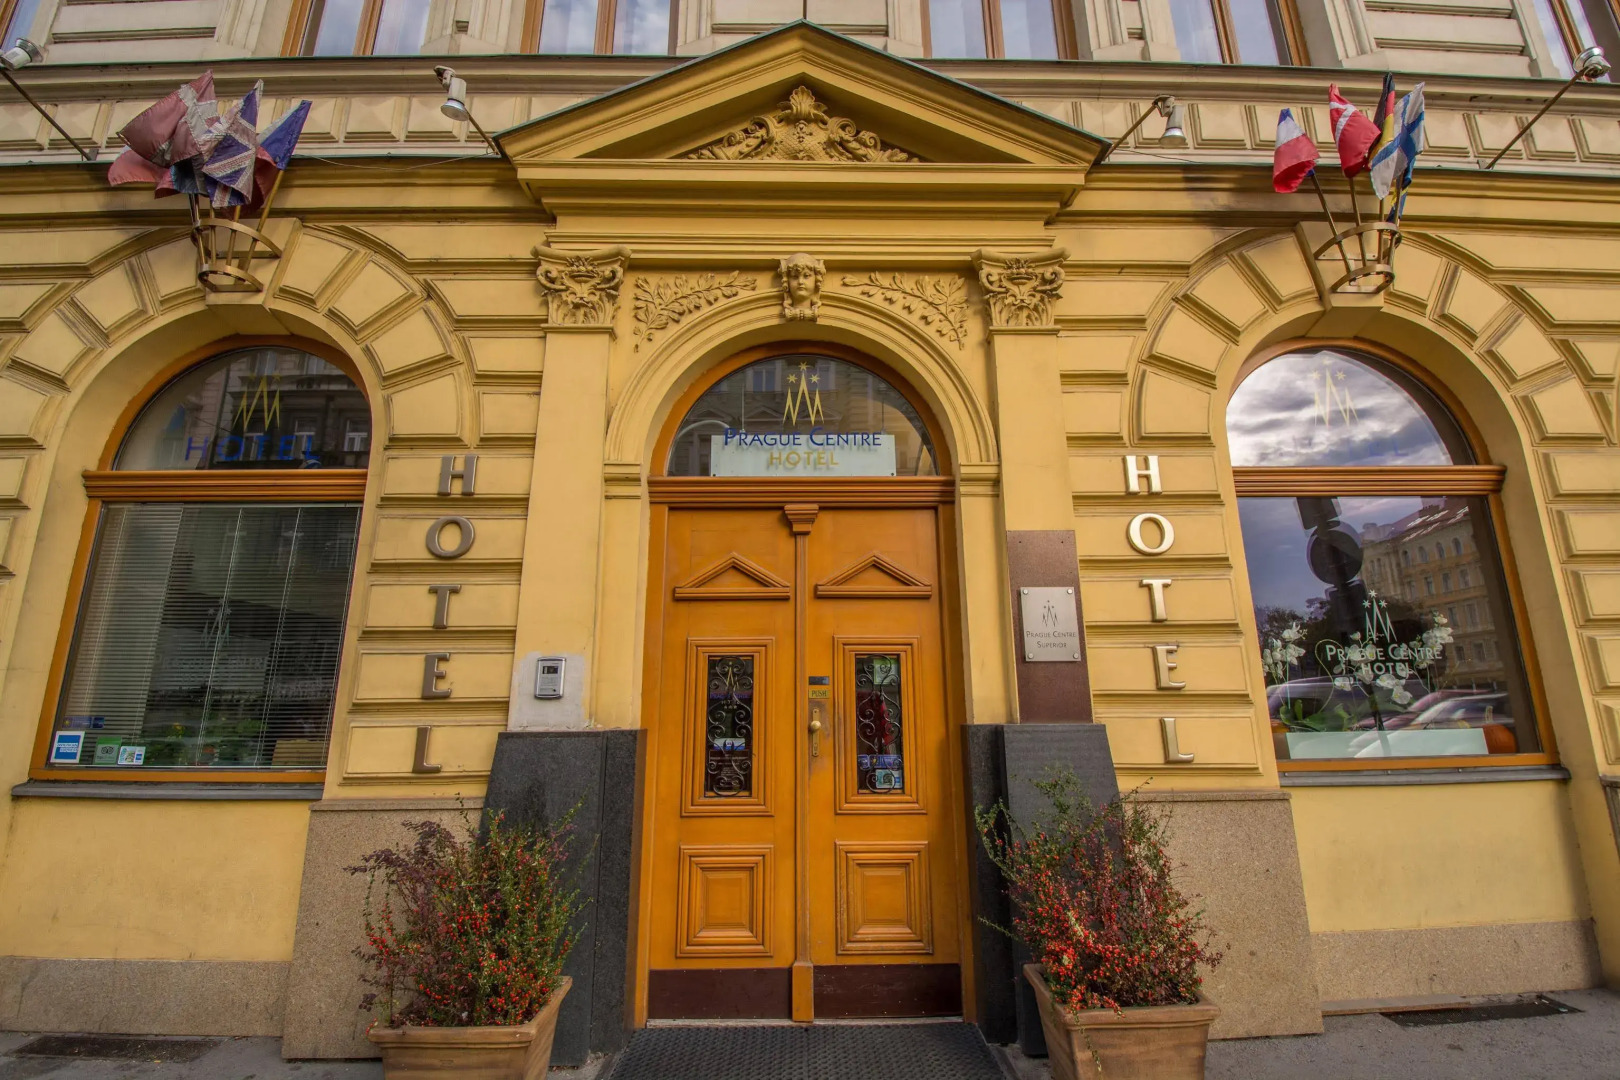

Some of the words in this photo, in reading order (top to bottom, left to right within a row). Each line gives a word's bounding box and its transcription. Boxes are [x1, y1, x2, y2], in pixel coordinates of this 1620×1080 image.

[724, 427, 802, 446] PRAGUE
[809, 426, 882, 446] CENTRE
[185, 434, 320, 461] HOTEL
[769, 451, 839, 466] HOTEL
[411, 454, 478, 774] HOTEL
[1123, 454, 1194, 763] HOTEL
[1026, 630, 1051, 638] PRAGUE
[1052, 630, 1076, 638] CENTRE
[1036, 641, 1067, 649] SUPERIOR
[1325, 644, 1385, 661] PRAGUE
[1388, 643, 1442, 660] CENTRE
[1361, 662, 1413, 675] HOTEL
